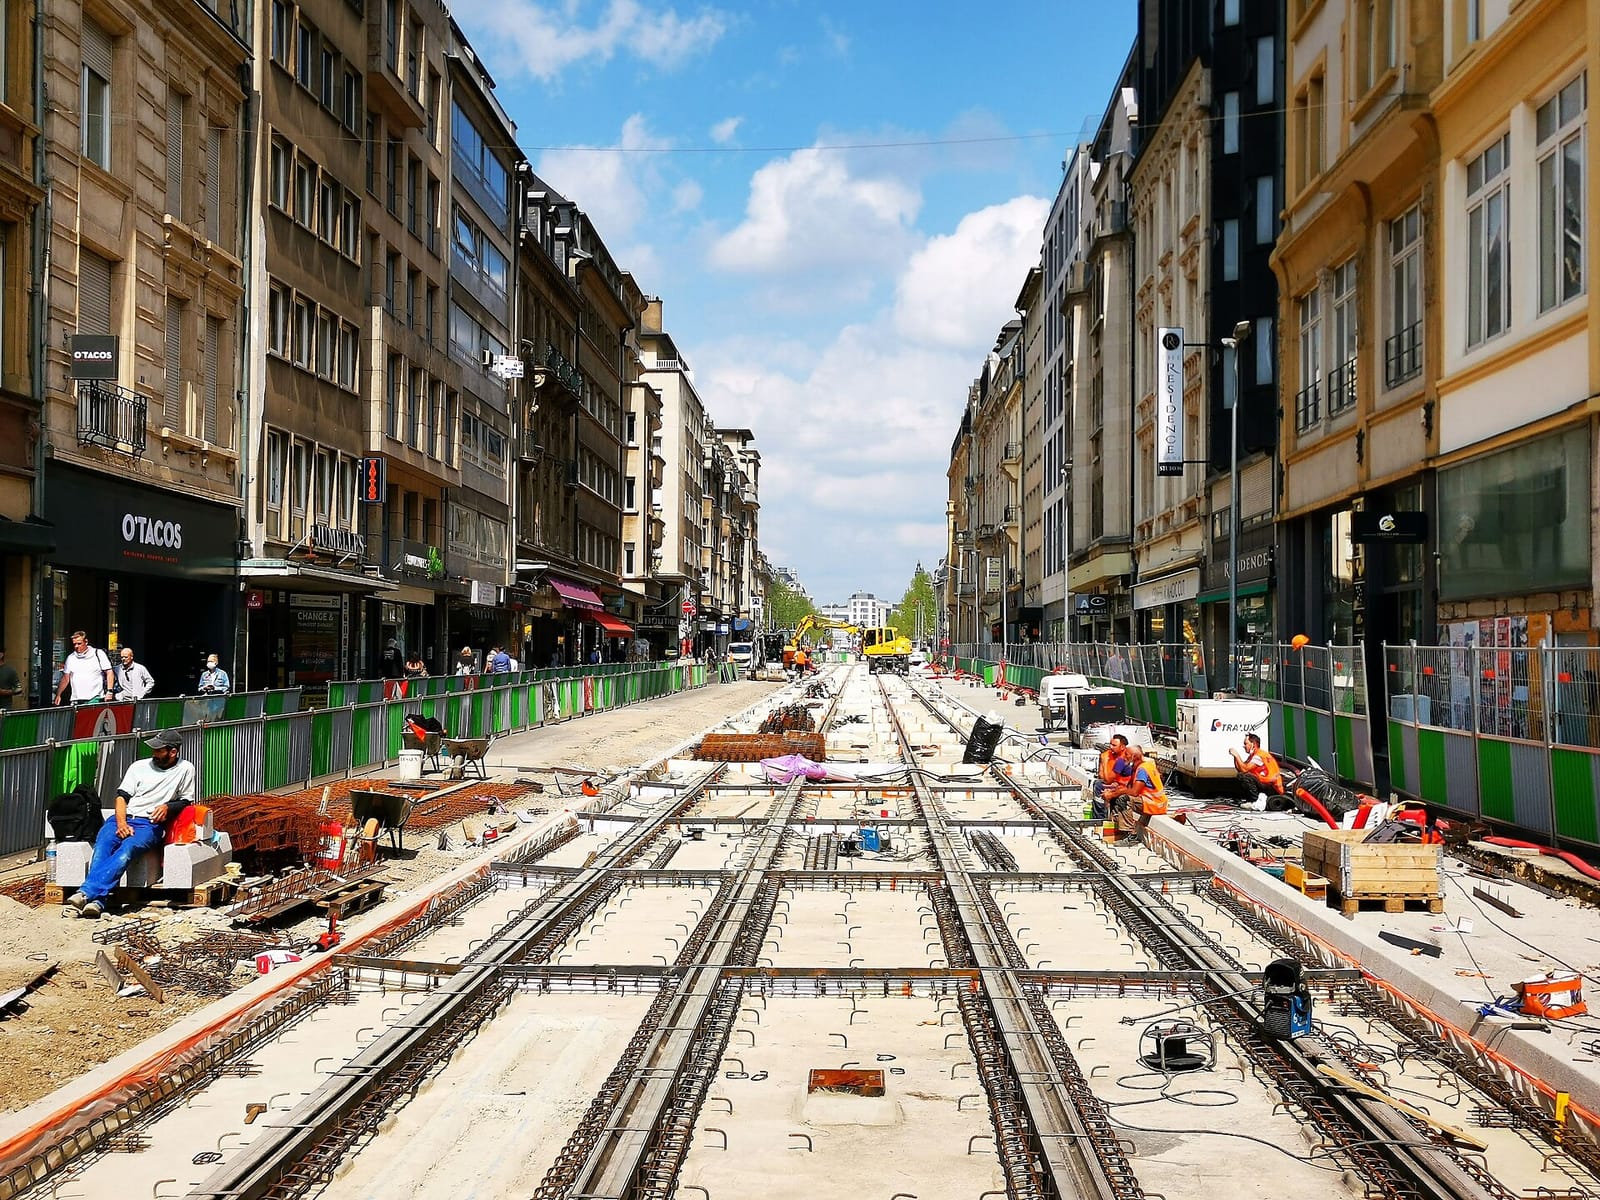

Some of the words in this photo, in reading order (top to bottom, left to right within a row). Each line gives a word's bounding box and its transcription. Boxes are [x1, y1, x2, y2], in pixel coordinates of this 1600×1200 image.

[74, 351, 112, 359] O'TACOS
[1165, 362, 1181, 454] RESIDENCE
[122, 513, 182, 549] O'TACOS
[1224, 552, 1268, 579] RIDENCE
[297, 611, 328, 621] CHANGE
